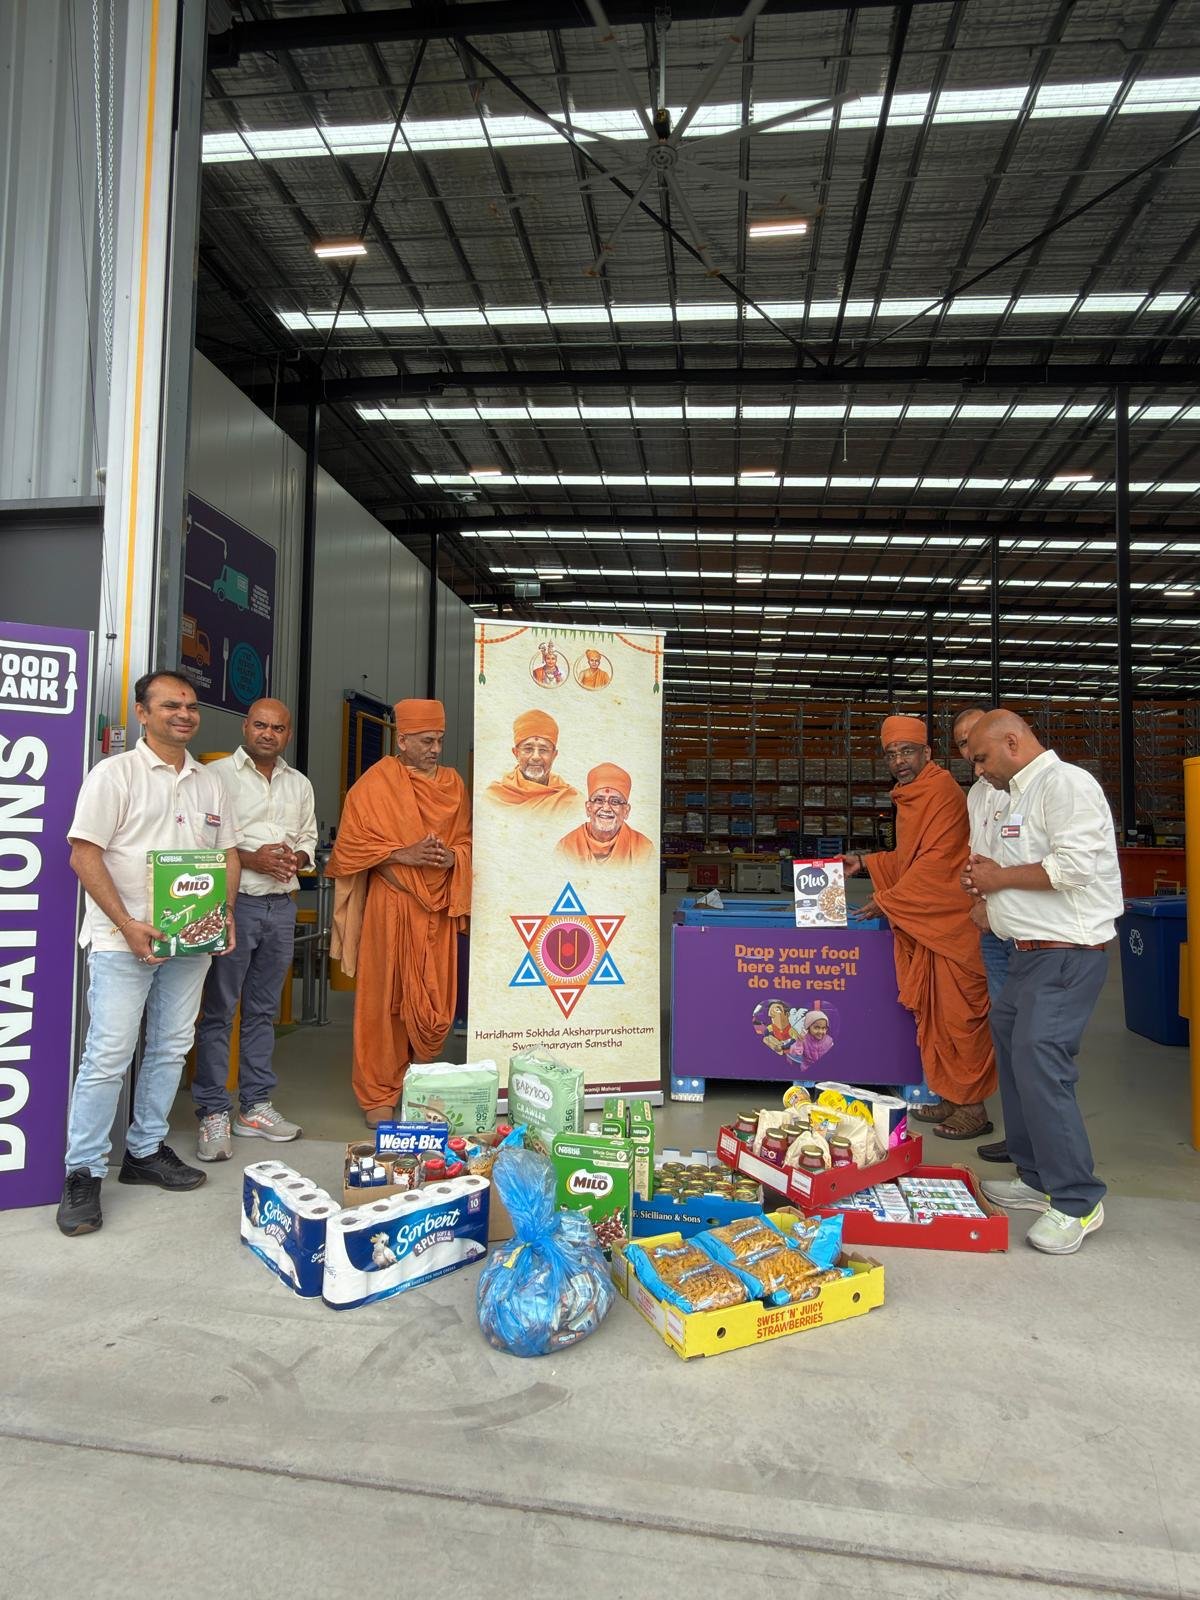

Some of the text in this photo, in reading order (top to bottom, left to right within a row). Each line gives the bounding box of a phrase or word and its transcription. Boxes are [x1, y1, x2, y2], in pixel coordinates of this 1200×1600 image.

[0, 653, 59, 679] OOD
[0, 676, 58, 701] ANK
[177, 881, 209, 891] MILO
[799, 874, 825, 890] Plus
[735, 944, 860, 962] Drop your food
[737, 958, 857, 976] here and we'll
[748, 975, 846, 991] do the rest!
[475, 1025, 654, 1040] Haridham Sokhda Aksharpurushottam
[512, 1038, 622, 1051] Swainarayan Sanstha
[515, 1079, 550, 1102] BABYBOO
[566, 1109, 573, 1121] 56
[380, 1134, 445, 1149] Weet-Bix
[573, 1176, 609, 1191] MILO
[470, 1199, 479, 1208] 10
[261, 1200, 292, 1232] Sorbent
[632, 1210, 639, 1218] F.
[682, 1214, 701, 1224] Sons
[396, 1208, 460, 1255] Sorbent
[757, 1311, 785, 1327] SWEET
[800, 1301, 824, 1316] JUICY
[757, 1312, 823, 1339] STRAWBERRIES
